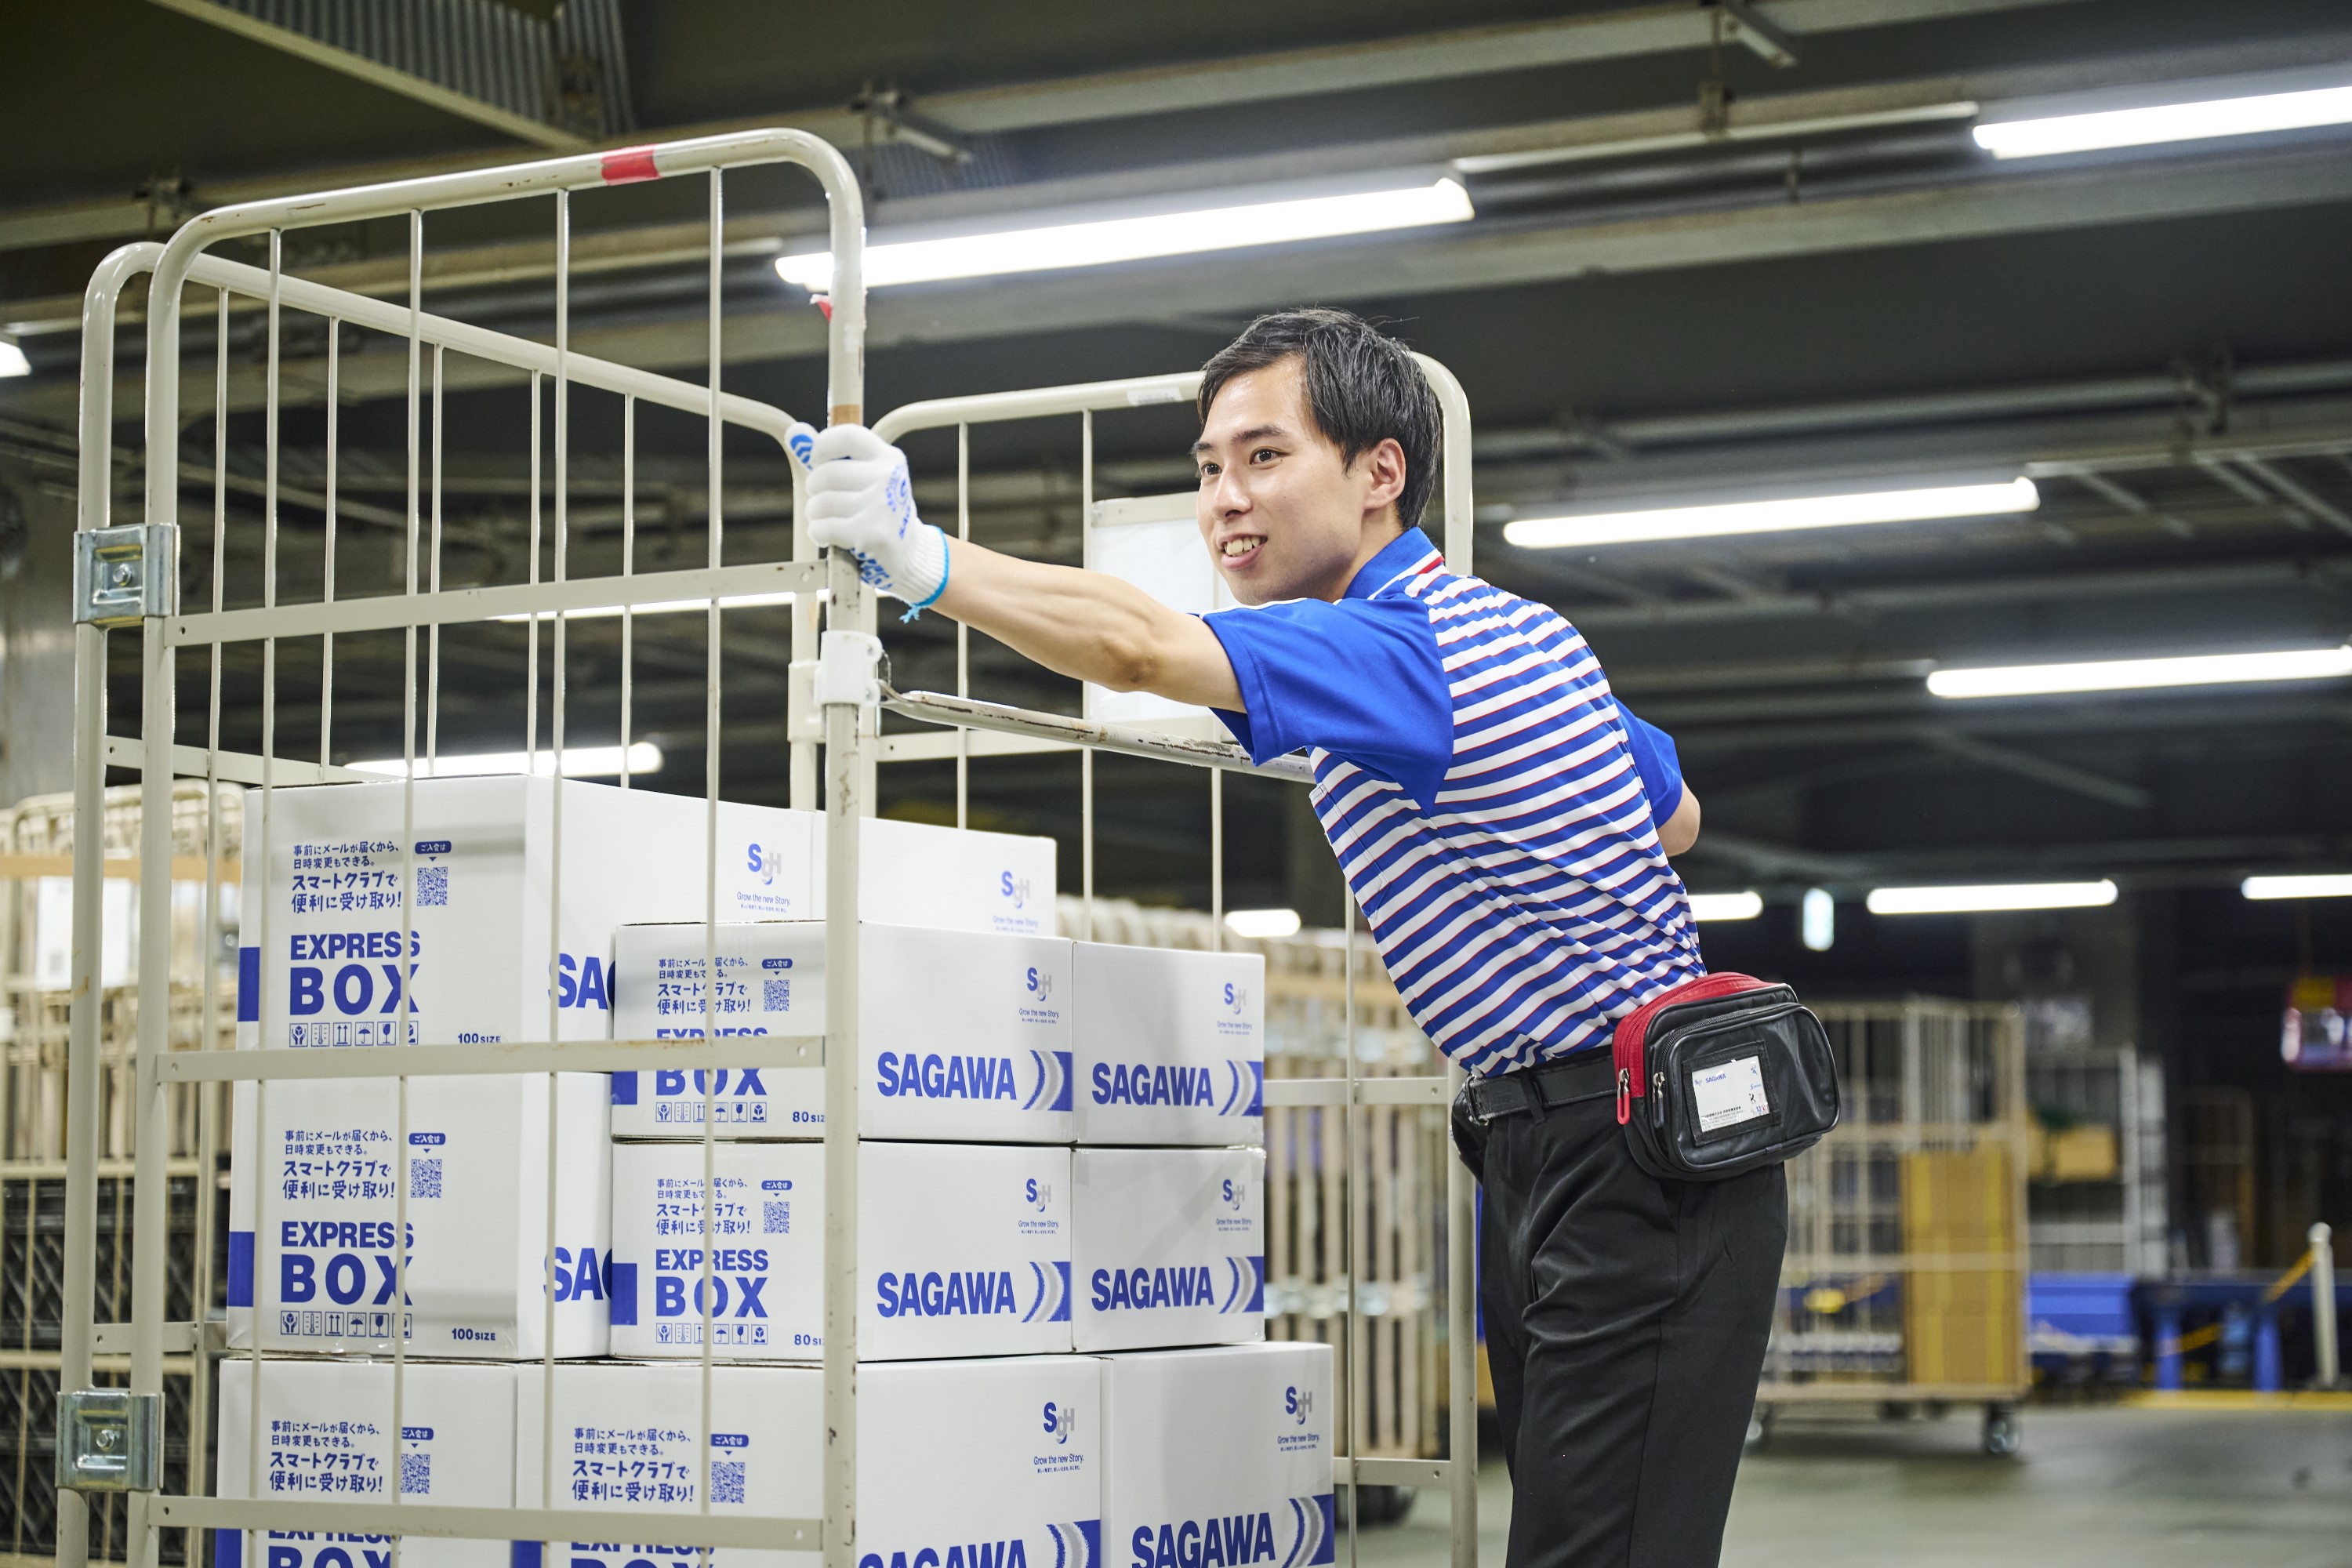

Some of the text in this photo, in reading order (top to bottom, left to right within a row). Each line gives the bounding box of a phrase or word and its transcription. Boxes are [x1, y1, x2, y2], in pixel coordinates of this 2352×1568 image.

[293, 841, 398, 856] 事前にメールが届くから、
[293, 856, 374, 869] 日時変更もできる。
[292, 871, 397, 891] スマートクラブで
[737, 892, 751, 901] Grow
[753, 894, 761, 902] the
[291, 931, 420, 960] EXPRESS
[659, 957, 749, 968] 事前にメール届くから、
[548, 953, 615, 1010] SA
[659, 969, 728, 979] 日時変更もでる。
[290, 964, 419, 1016] BOX
[658, 982, 748, 996] スマートラブで
[877, 1051, 1017, 1100] SAGAWA
[1091, 1062, 1214, 1107] SAGAWA
[285, 1129, 392, 1142] 事前にメールが届くから、
[285, 1144, 368, 1156] 日時変更もできる。
[283, 1160, 392, 1177] スマートクラブで
[657, 1178, 748, 1189] 事前にメール届くから、
[657, 1189, 727, 1200] 日時変更もでる。
[656, 1203, 747, 1217] スマートラブで
[281, 1221, 414, 1249] EXPRESS
[655, 1249, 768, 1272] EXPRESS
[281, 1253, 412, 1306] BOX
[877, 1272, 1017, 1318] SAGAWA
[1091, 1266, 1214, 1312] SAGAWA
[655, 1276, 768, 1319] BOX
[271, 1421, 379, 1435] 事前にメールが届くから、
[574, 1427, 691, 1442] 事前にメールが届くから、
[272, 1435, 354, 1448] 日時変更もできる。
[575, 1443, 664, 1456] 日時変更もできる。
[270, 1451, 379, 1471] スマートクラブで
[1034, 1456, 1047, 1465] Grow
[1069, 1454, 1084, 1464] Story.
[572, 1460, 690, 1479] スマートクラブで
[1131, 1512, 1276, 1568] SAGAWA
